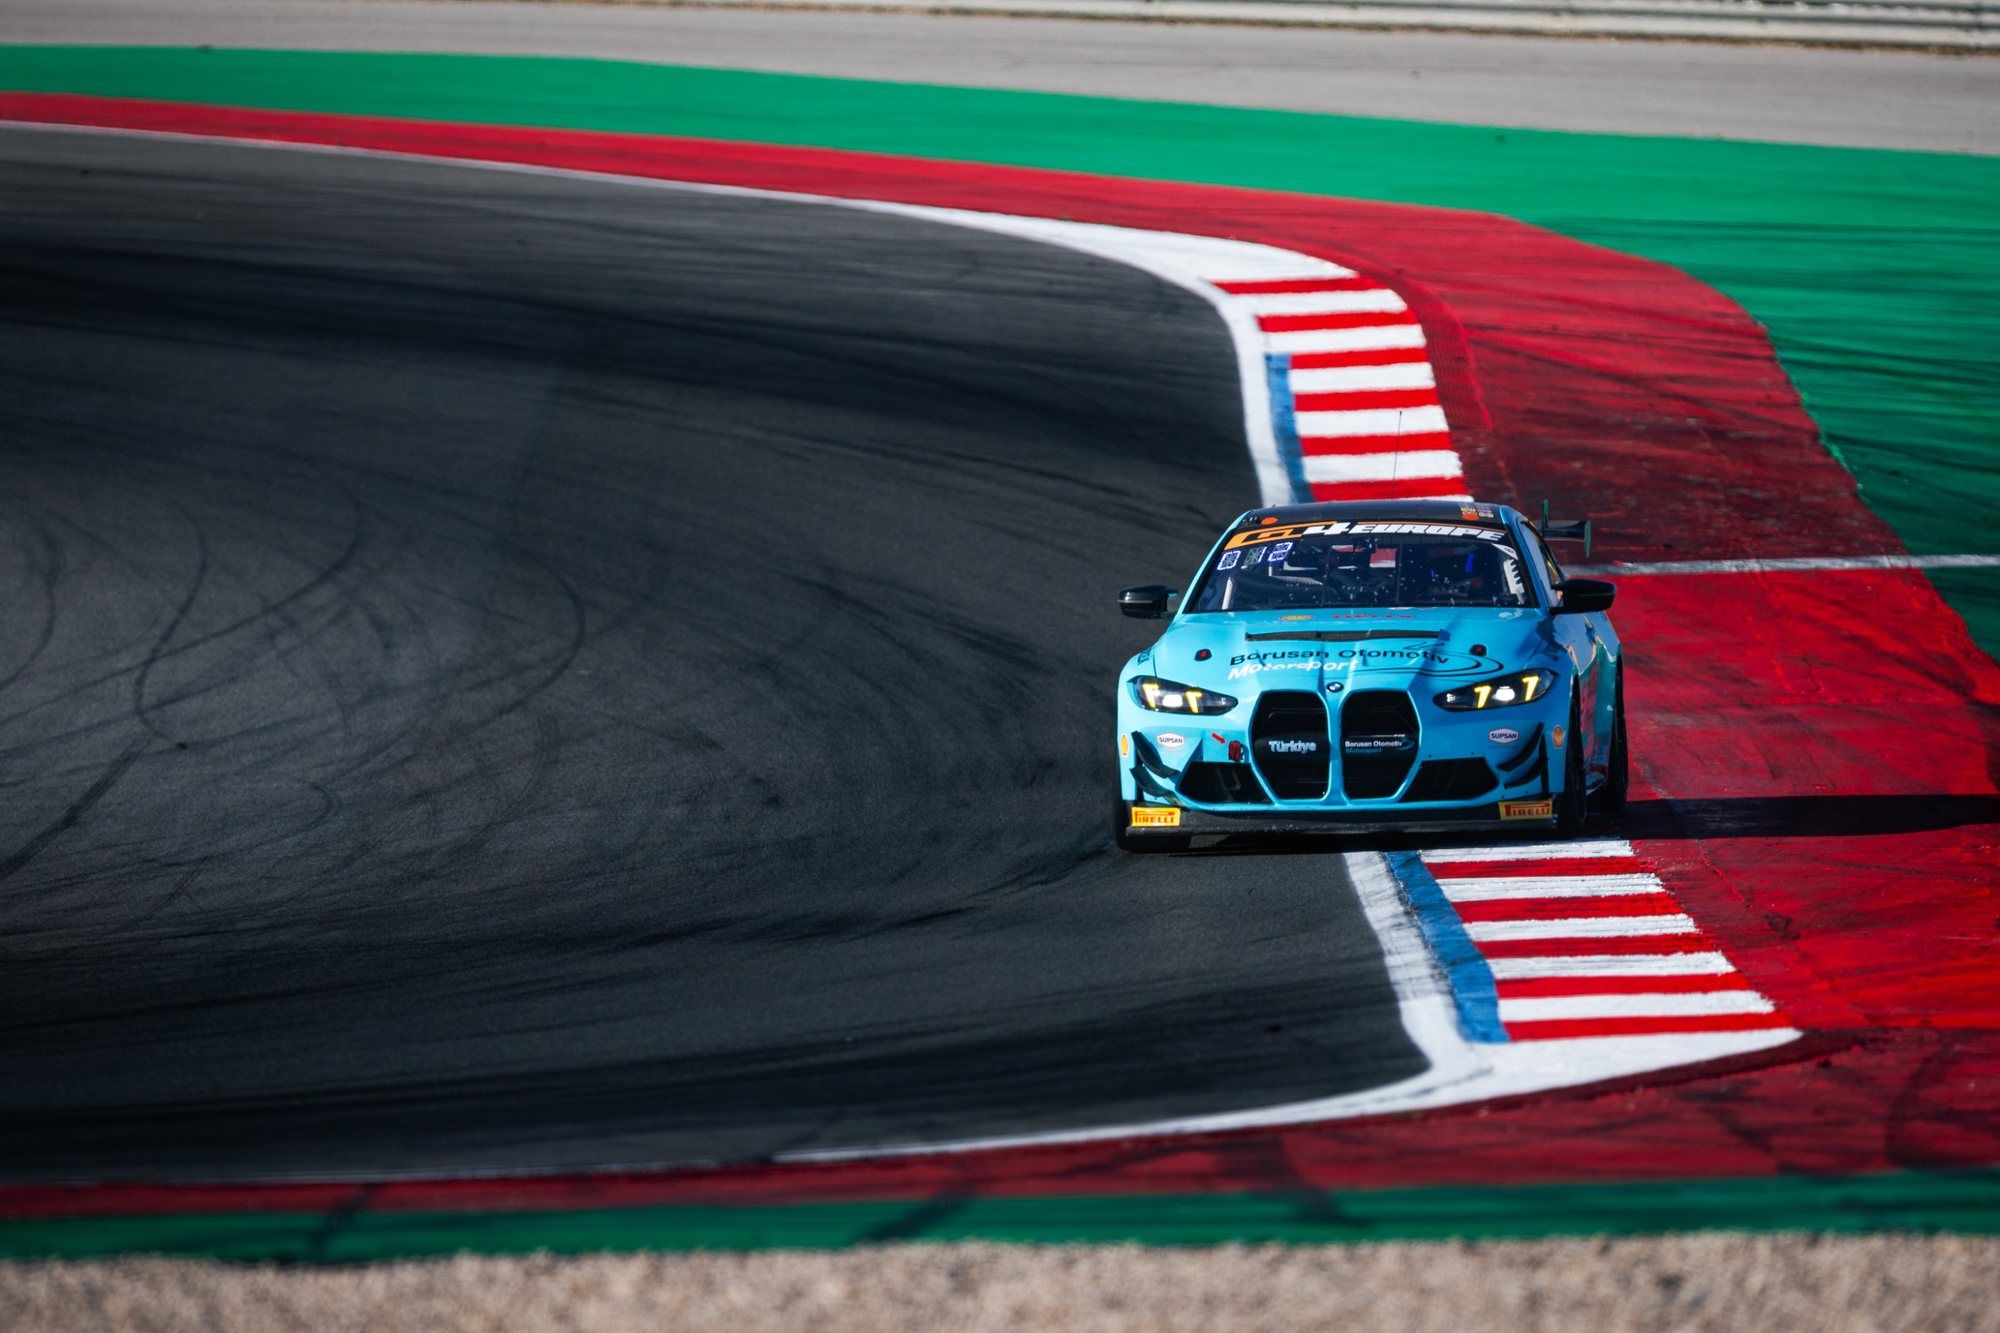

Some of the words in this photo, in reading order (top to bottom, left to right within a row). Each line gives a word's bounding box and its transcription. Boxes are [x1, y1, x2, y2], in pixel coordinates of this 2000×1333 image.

[1230, 649, 1330, 666] Borusan
[1338, 648, 1450, 664] Otomotiv
[1227, 659, 1359, 680] Motorsport
[1158, 736, 1183, 744] SUPSAN
[1504, 802, 1550, 816] PIRELLI
[1134, 811, 1175, 824] PIRELLI
